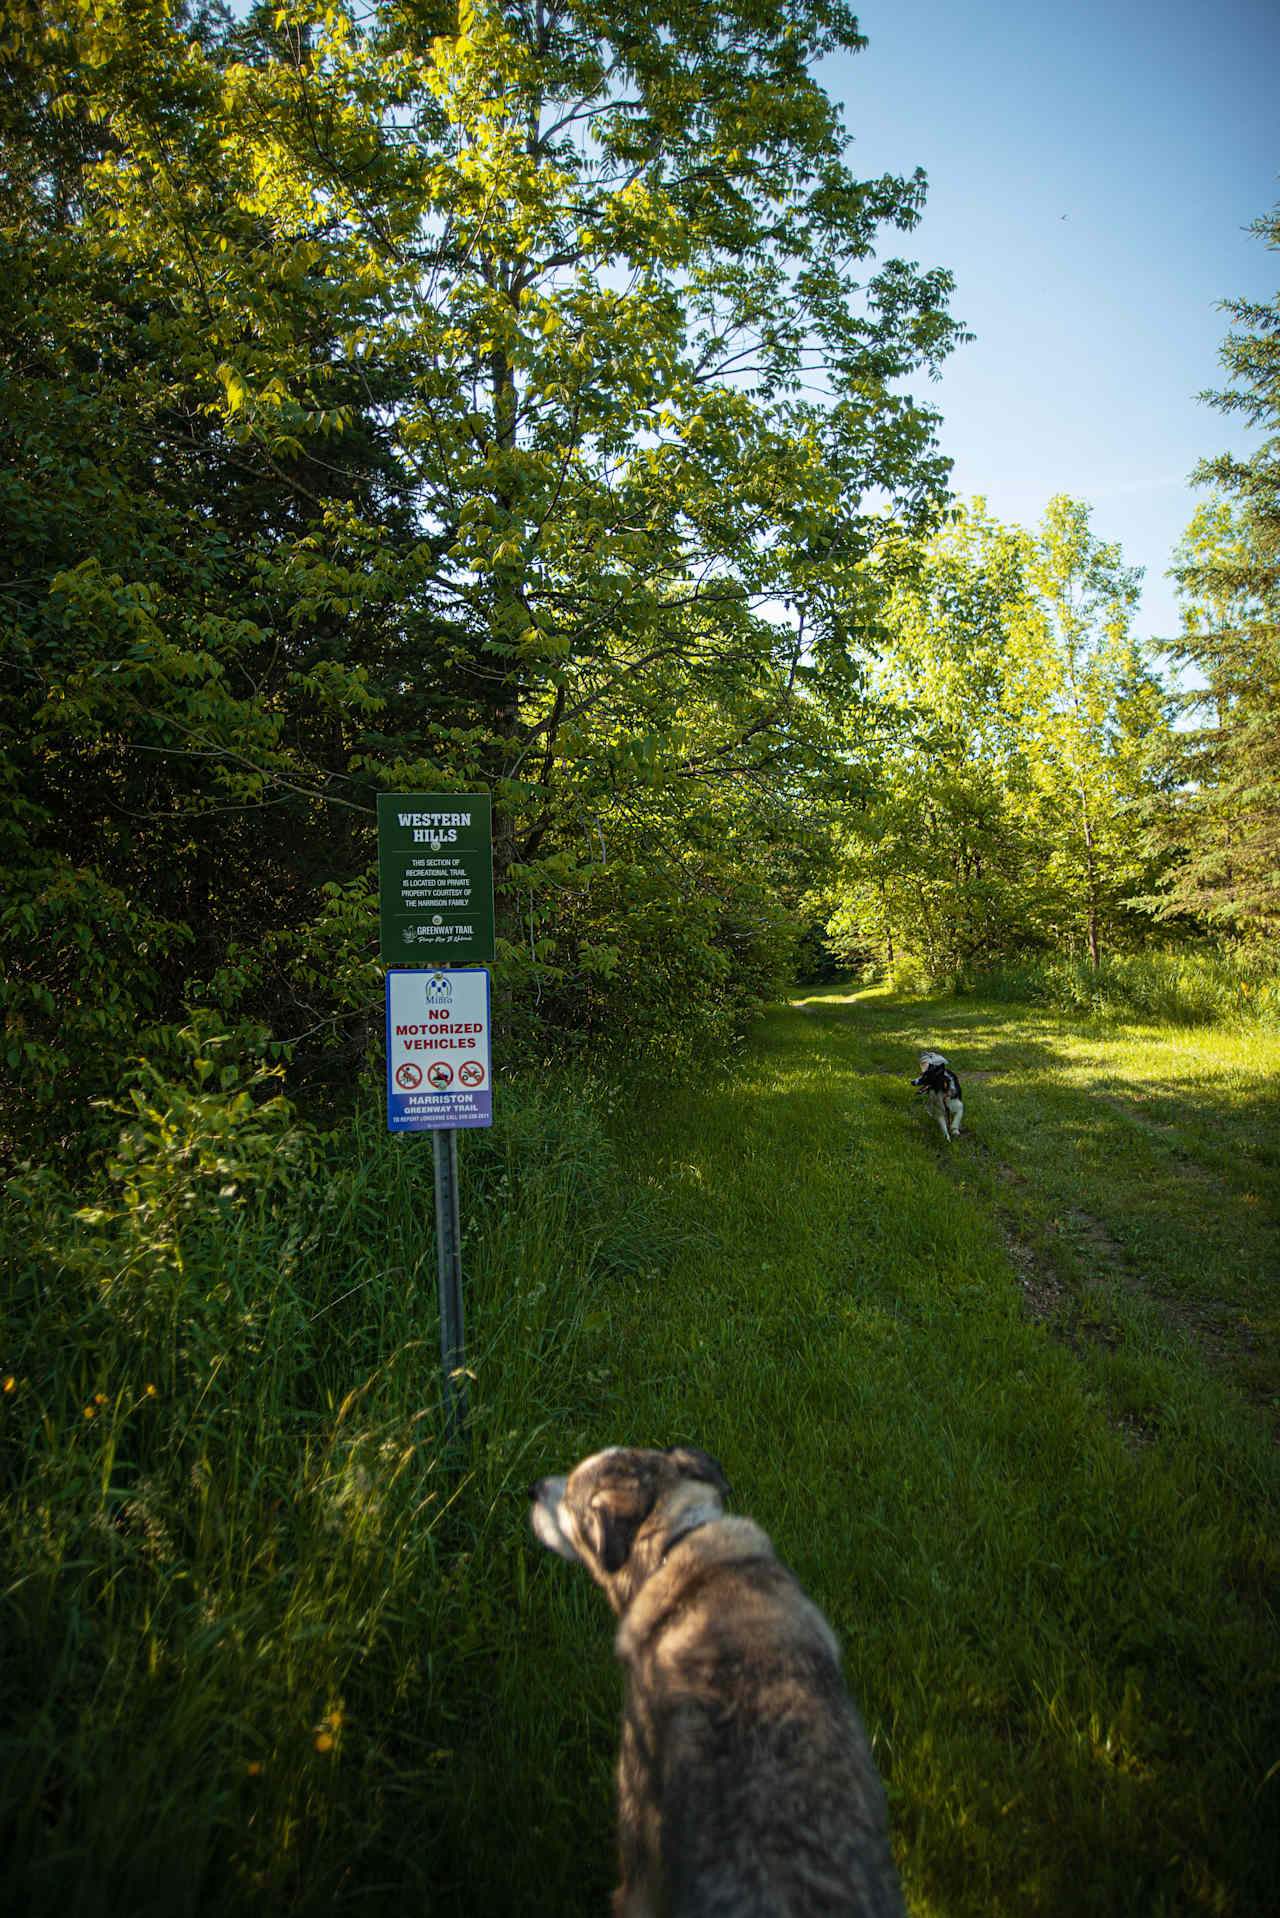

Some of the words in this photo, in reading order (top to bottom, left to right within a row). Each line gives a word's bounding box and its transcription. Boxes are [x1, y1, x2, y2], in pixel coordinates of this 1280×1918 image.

[397, 813, 471, 826] WESTERN
[413, 829, 457, 842] HILLS
[464, 888, 472, 896] OF
[448, 898, 469, 906] FAMILY
[417, 925, 454, 935] GREENWAY
[455, 925, 474, 934] TRAIL
[425, 995, 453, 1004] Minto
[428, 1009, 450, 1020] NO
[396, 1024, 483, 1036] MOTORIZED
[403, 1038, 476, 1050] VEHICLES
[408, 1094, 473, 1105] HARRISTON
[403, 1105, 452, 1114] GREENWAY
[453, 1104, 479, 1112] TRAIL
